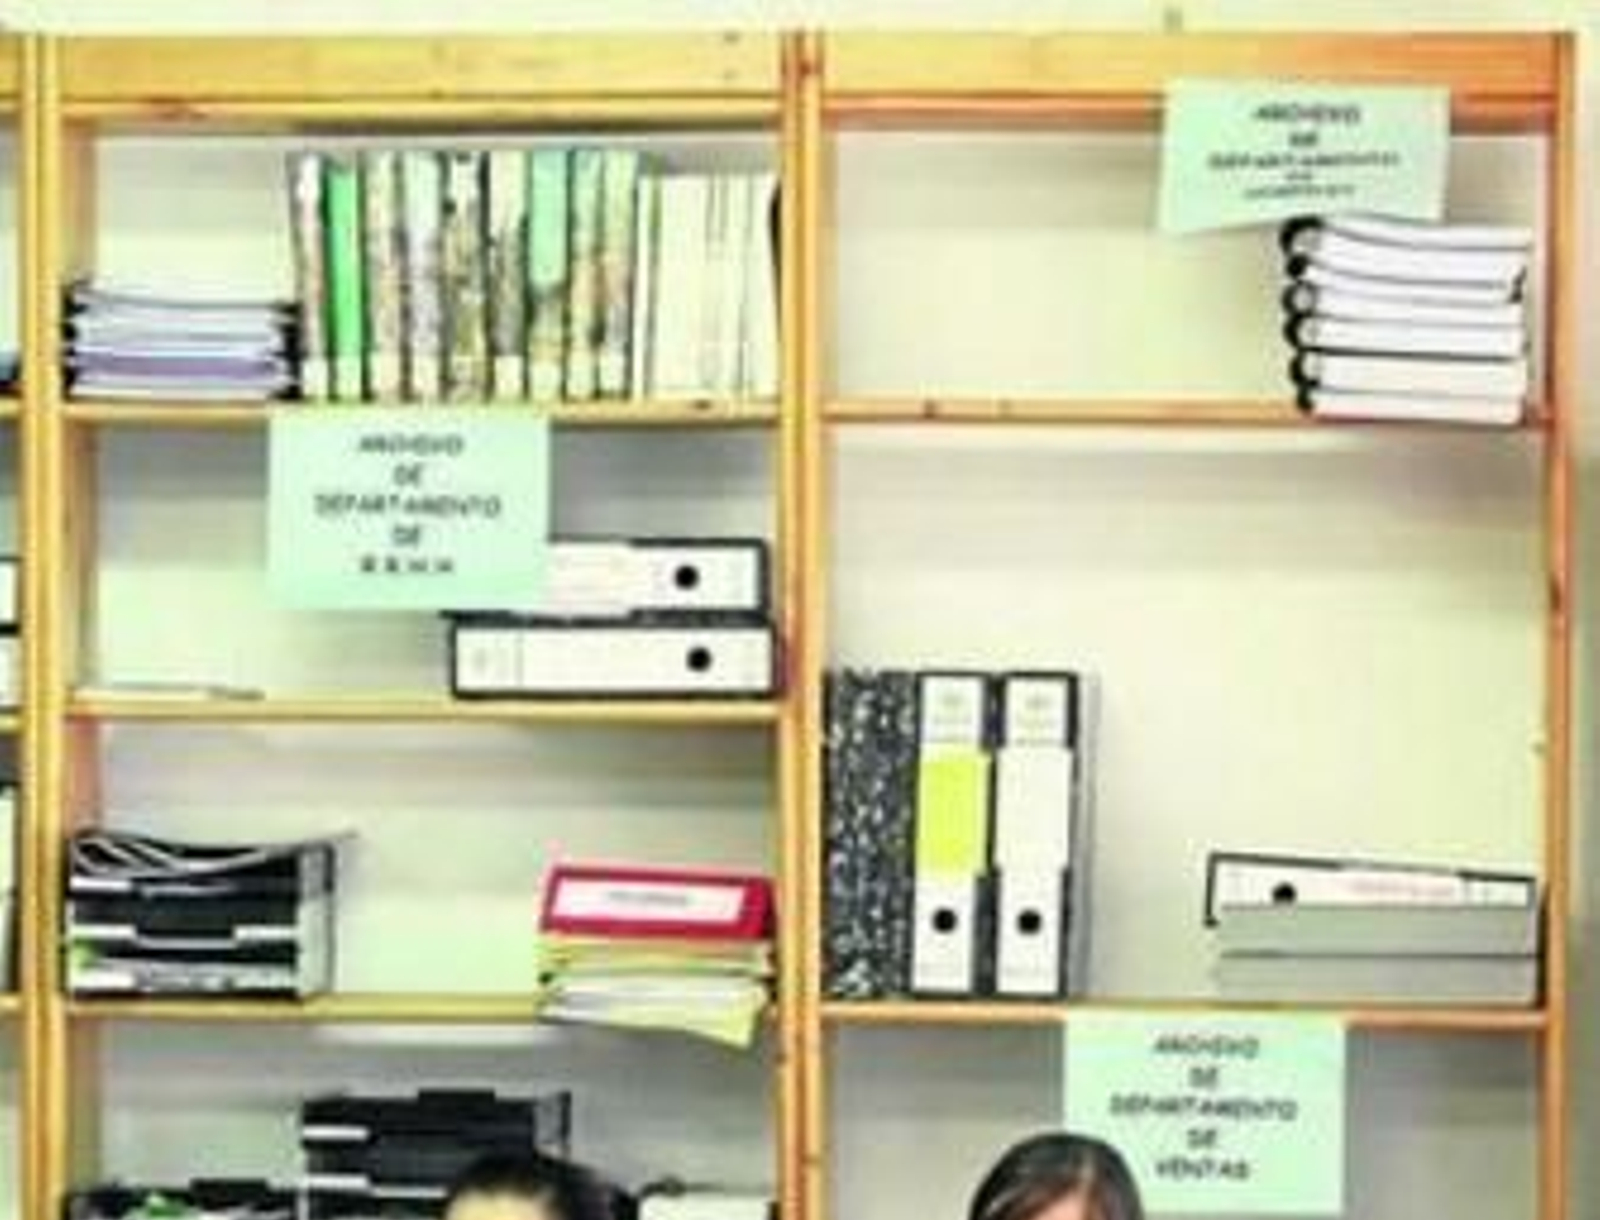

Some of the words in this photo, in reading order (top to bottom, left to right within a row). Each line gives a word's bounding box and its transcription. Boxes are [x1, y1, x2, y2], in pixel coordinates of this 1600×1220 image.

[314, 494, 502, 517] DEPARTAMENTO
[1109, 1094, 1298, 1121] DEPARTAMENTO
[1155, 1157, 1251, 1181] VENTAS
